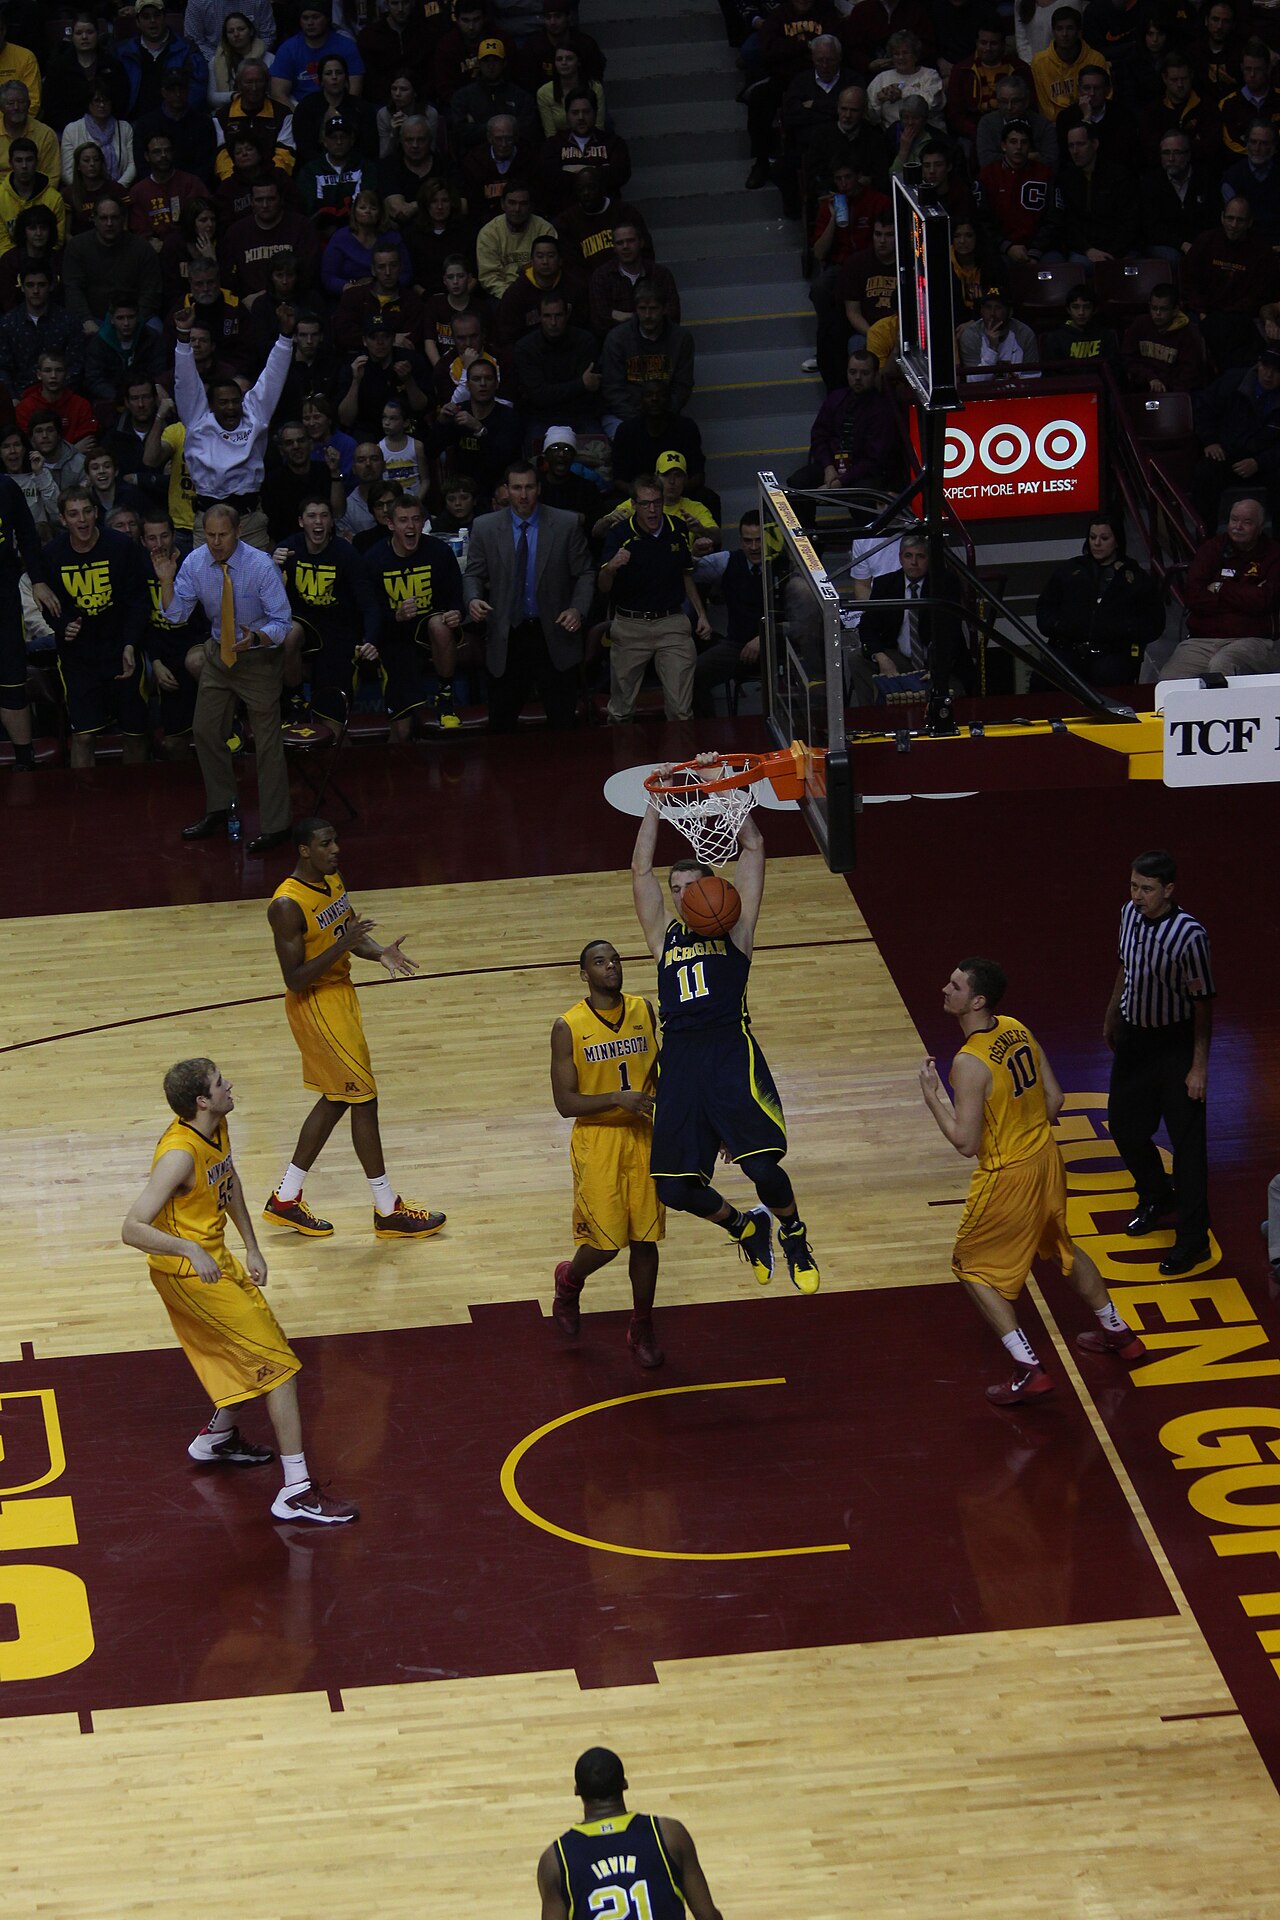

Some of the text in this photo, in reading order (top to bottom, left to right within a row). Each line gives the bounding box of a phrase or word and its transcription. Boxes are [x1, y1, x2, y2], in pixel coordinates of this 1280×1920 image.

[1020, 181, 1048, 211] C
[1071, 340, 1102, 359] NIKE
[944, 486, 978, 499] XPECT
[1017, 482, 1038, 495] PAY
[61, 566, 112, 597] WE
[384, 571, 433, 601] WE
[1170, 717, 1261, 757] TCF
[677, 961, 710, 1003] 11
[583, 1035, 649, 1063] MINNESOTA
[618, 1060, 632, 1092] 1
[1006, 1045, 1039, 1099] 10
[591, 1855, 637, 1880] IRVIN
[588, 1879, 654, 1920] 21
